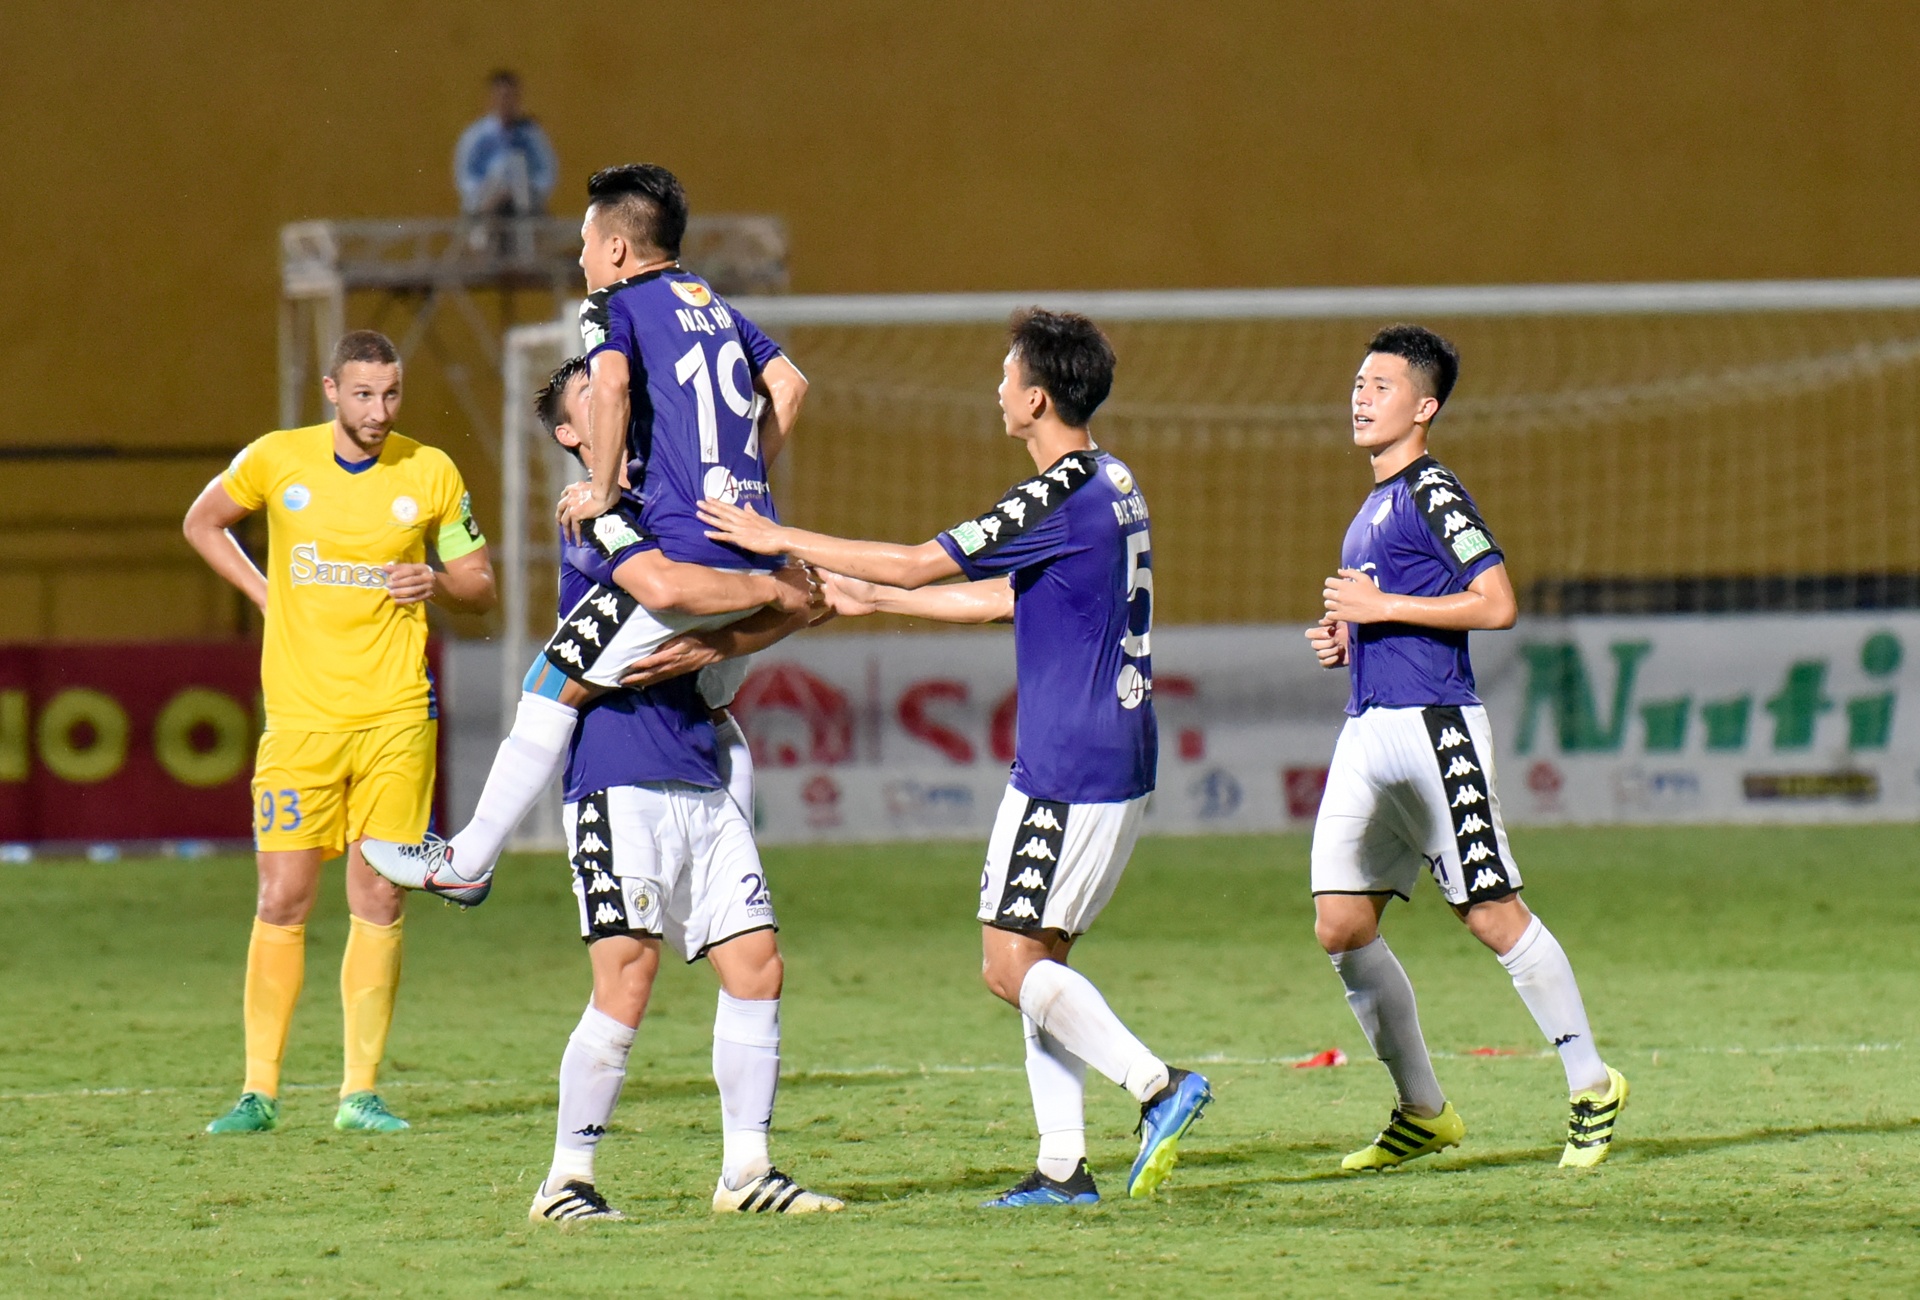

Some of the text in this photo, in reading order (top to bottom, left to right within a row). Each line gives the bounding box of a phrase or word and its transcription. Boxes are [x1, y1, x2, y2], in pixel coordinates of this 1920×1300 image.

[675, 340, 758, 463] 19
[1454, 532, 1486, 554] NUTI
[1120, 530, 1153, 657] 5
[259, 789, 301, 831] 93
